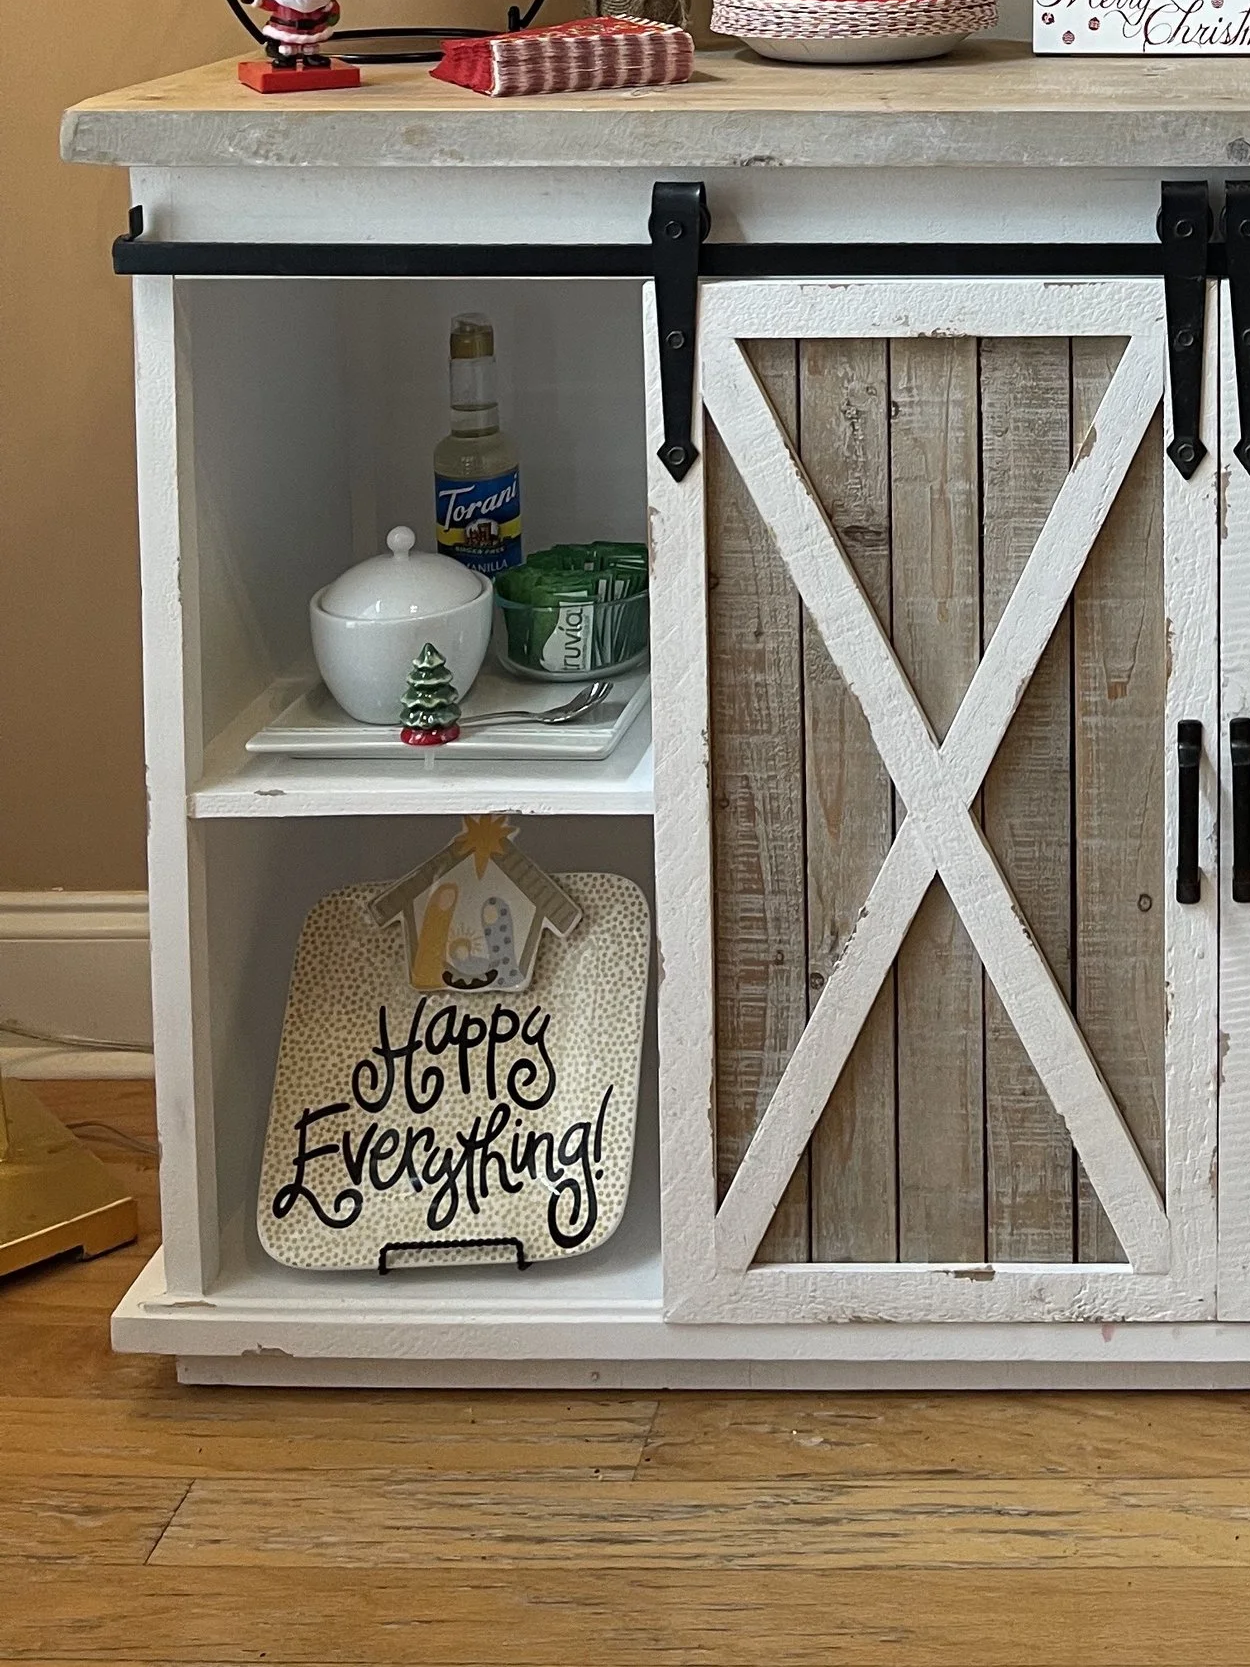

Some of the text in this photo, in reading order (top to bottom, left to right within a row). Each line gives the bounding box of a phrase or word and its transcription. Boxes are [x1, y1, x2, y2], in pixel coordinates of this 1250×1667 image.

[439, 472, 518, 532] Torani
[351, 996, 557, 1115] Happy
[272, 1084, 614, 1249] Everything!
